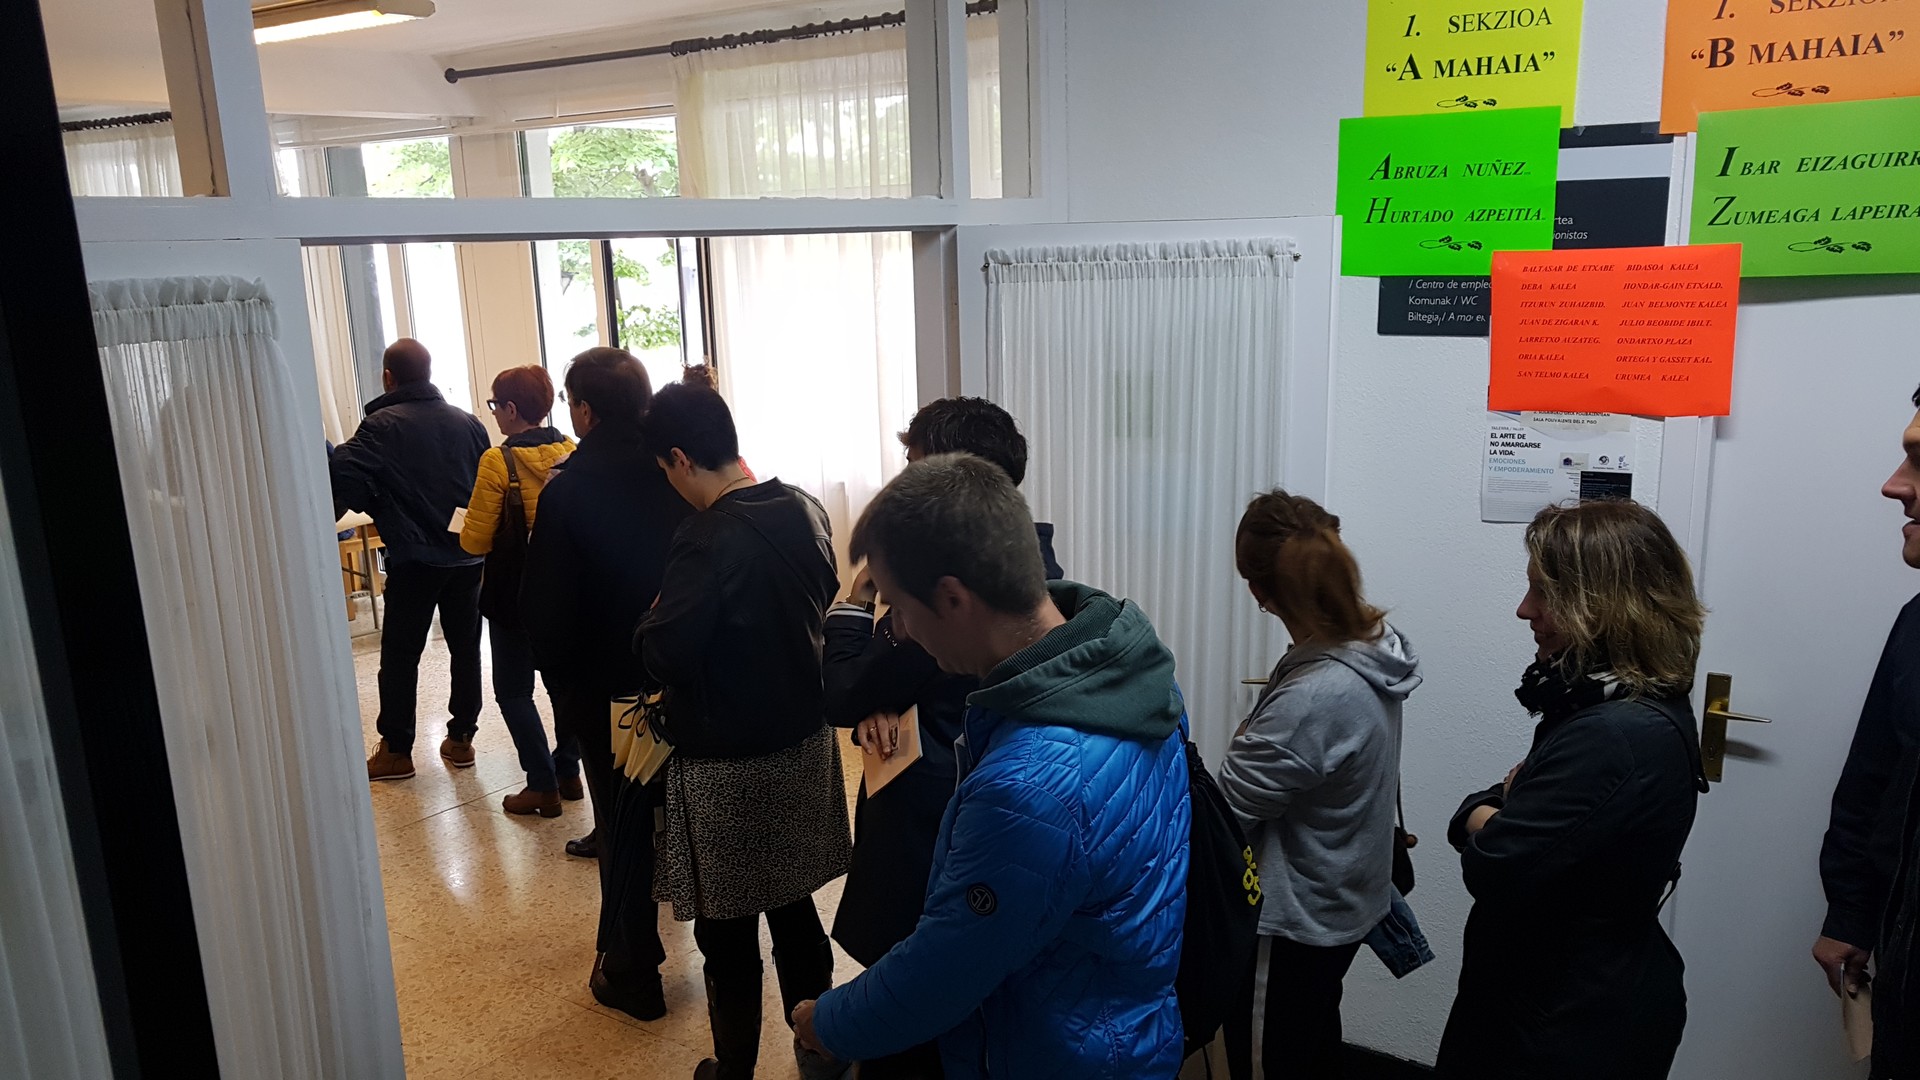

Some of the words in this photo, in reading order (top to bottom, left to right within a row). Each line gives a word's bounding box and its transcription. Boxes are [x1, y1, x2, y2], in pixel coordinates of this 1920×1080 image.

[1403, 14, 1421, 37] 1.
[1447, 7, 1552, 34] SEKZIOA
[1368, 153, 1449, 180] ABRUZA
[1363, 197, 1454, 224] HURTADO
[1707, 196, 1821, 226] ZUMEAGA
[1522, 265, 1563, 273] BALTASAR
[1581, 264, 1615, 272] ETXABE
[1626, 264, 1664, 272] BIDASOA
[1670, 263, 1699, 271] KALEA
[1415, 279, 1445, 289] Centro
[1446, 279, 1459, 289] de
[1521, 283, 1543, 291] DEBA
[1550, 283, 1577, 291] KALEA
[1623, 282, 1685, 290] HONDAR-GAIN
[1686, 282, 1723, 290] ETXALD.
[1408, 296, 1452, 306] Komunak
[1461, 296, 1479, 306] WC
[1520, 301, 1556, 309] ITZURUN
[1559, 301, 1606, 309] ZUHAIZBID.
[1622, 301, 1646, 309] JUAN
[1648, 301, 1697, 309] BELMONTE
[1698, 301, 1728, 309] KALEA
[1592, 319, 1600, 327] K.
[1619, 319, 1646, 327] JULIO
[1646, 319, 1686, 327] BEOBIDE
[1687, 319, 1713, 327] IBILT.
[1519, 336, 1561, 344] LARRETXO
[1561, 337, 1601, 345] AUZATEG.
[1617, 337, 1664, 345] ONDARTXO
[1664, 338, 1693, 346] PLAZA
[1518, 353, 1538, 361] ORIA
[1538, 353, 1565, 362] KALEA
[1616, 355, 1650, 363] ORTEGA
[1659, 356, 1692, 364] GASSET
[1517, 370, 1534, 378] SAN
[1534, 371, 1562, 379] TELMO
[1563, 371, 1590, 379] KALEA
[1615, 373, 1651, 381] URUMEA
[1661, 374, 1690, 382] KALEA
[1500, 441, 1542, 449] AMARGARSE
[1494, 466, 1555, 475] EMPODERAMIENTO
